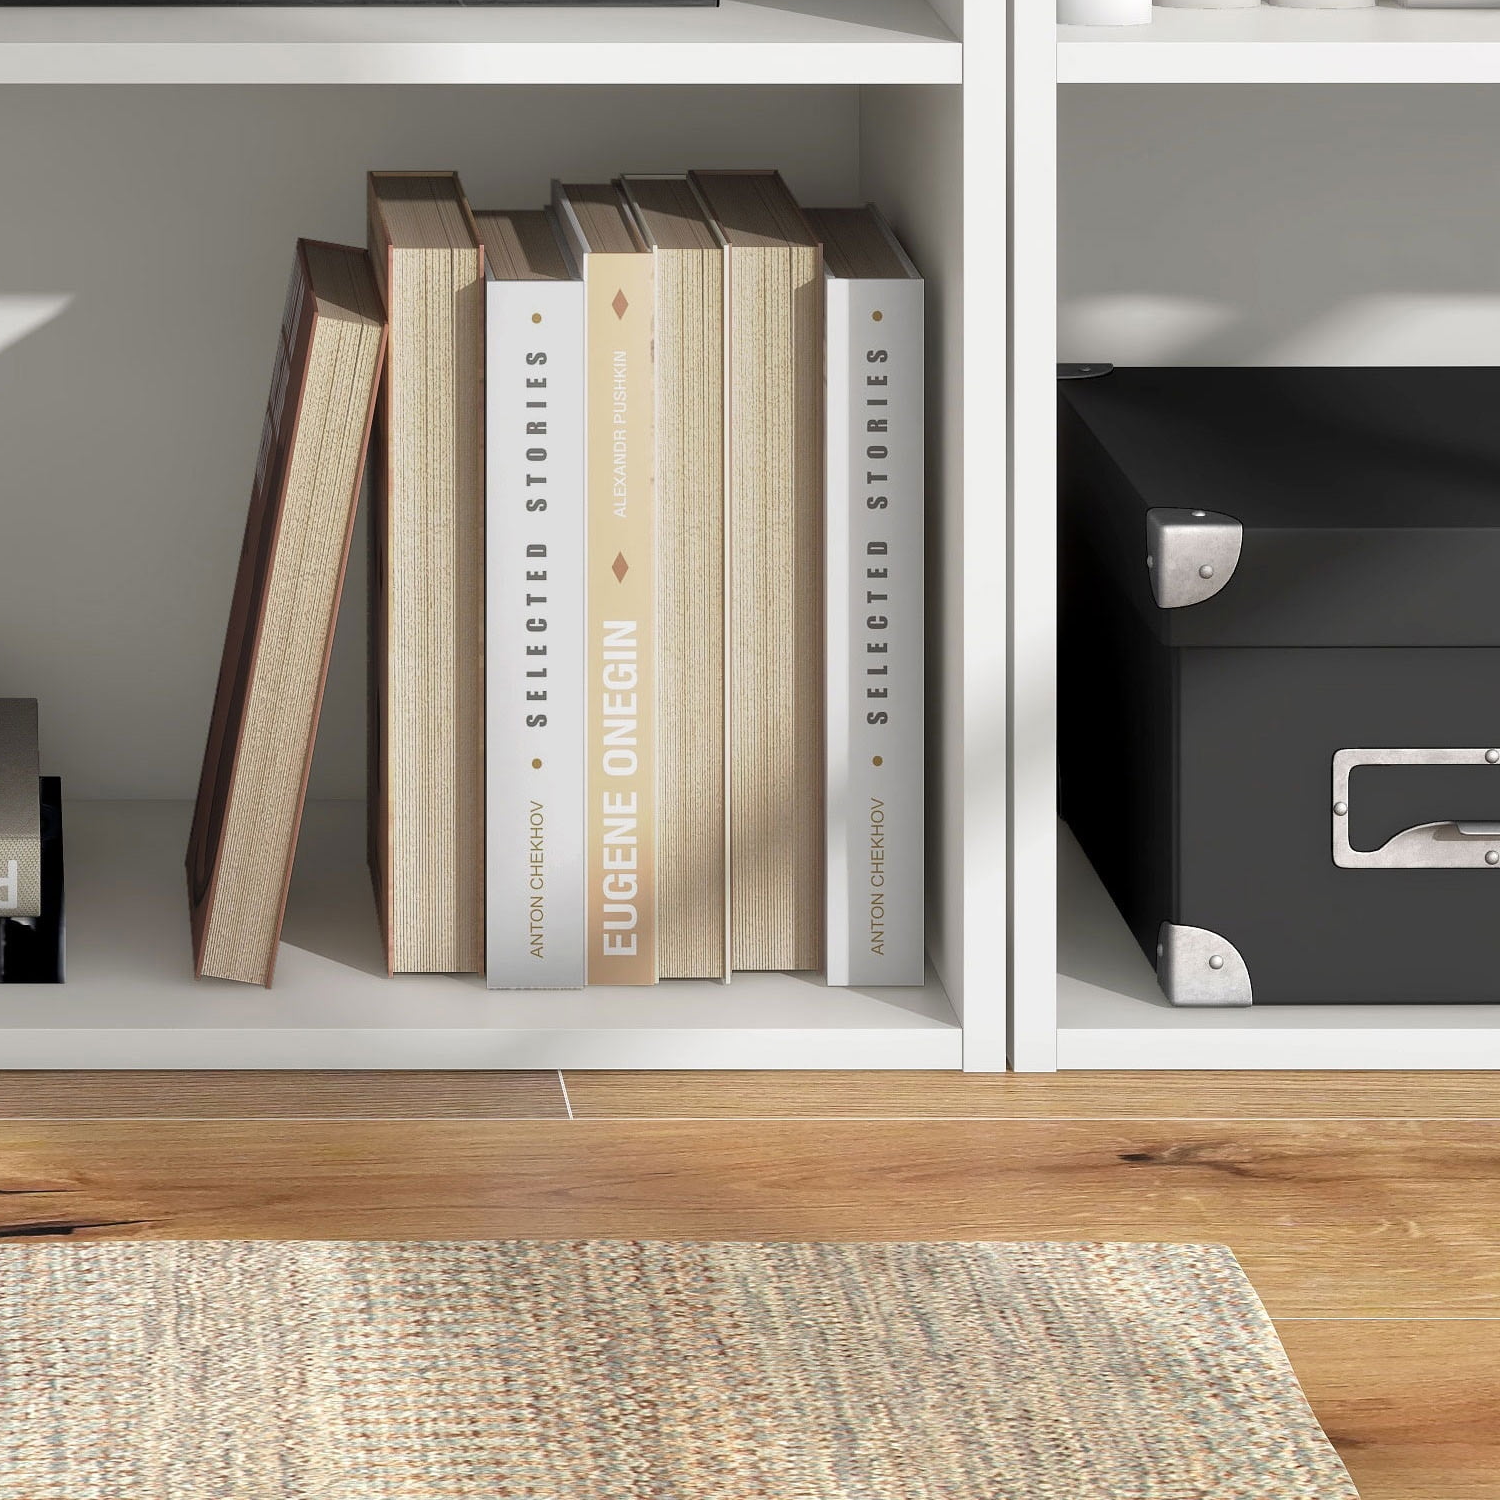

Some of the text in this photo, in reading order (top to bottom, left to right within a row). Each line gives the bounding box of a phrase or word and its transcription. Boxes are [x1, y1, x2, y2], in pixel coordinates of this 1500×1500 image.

[526, 351, 548, 728] SELECTED STORIES
[613, 350, 628, 518] ALEXANDR PUSHKIN
[867, 349, 889, 726] SELECTED STORIES
[529, 799, 545, 959] ANTON CHEKHOV
[603, 620, 638, 956] EUGENE ONEGIN
[870, 796, 885, 956] ANTON CHEKHOV
